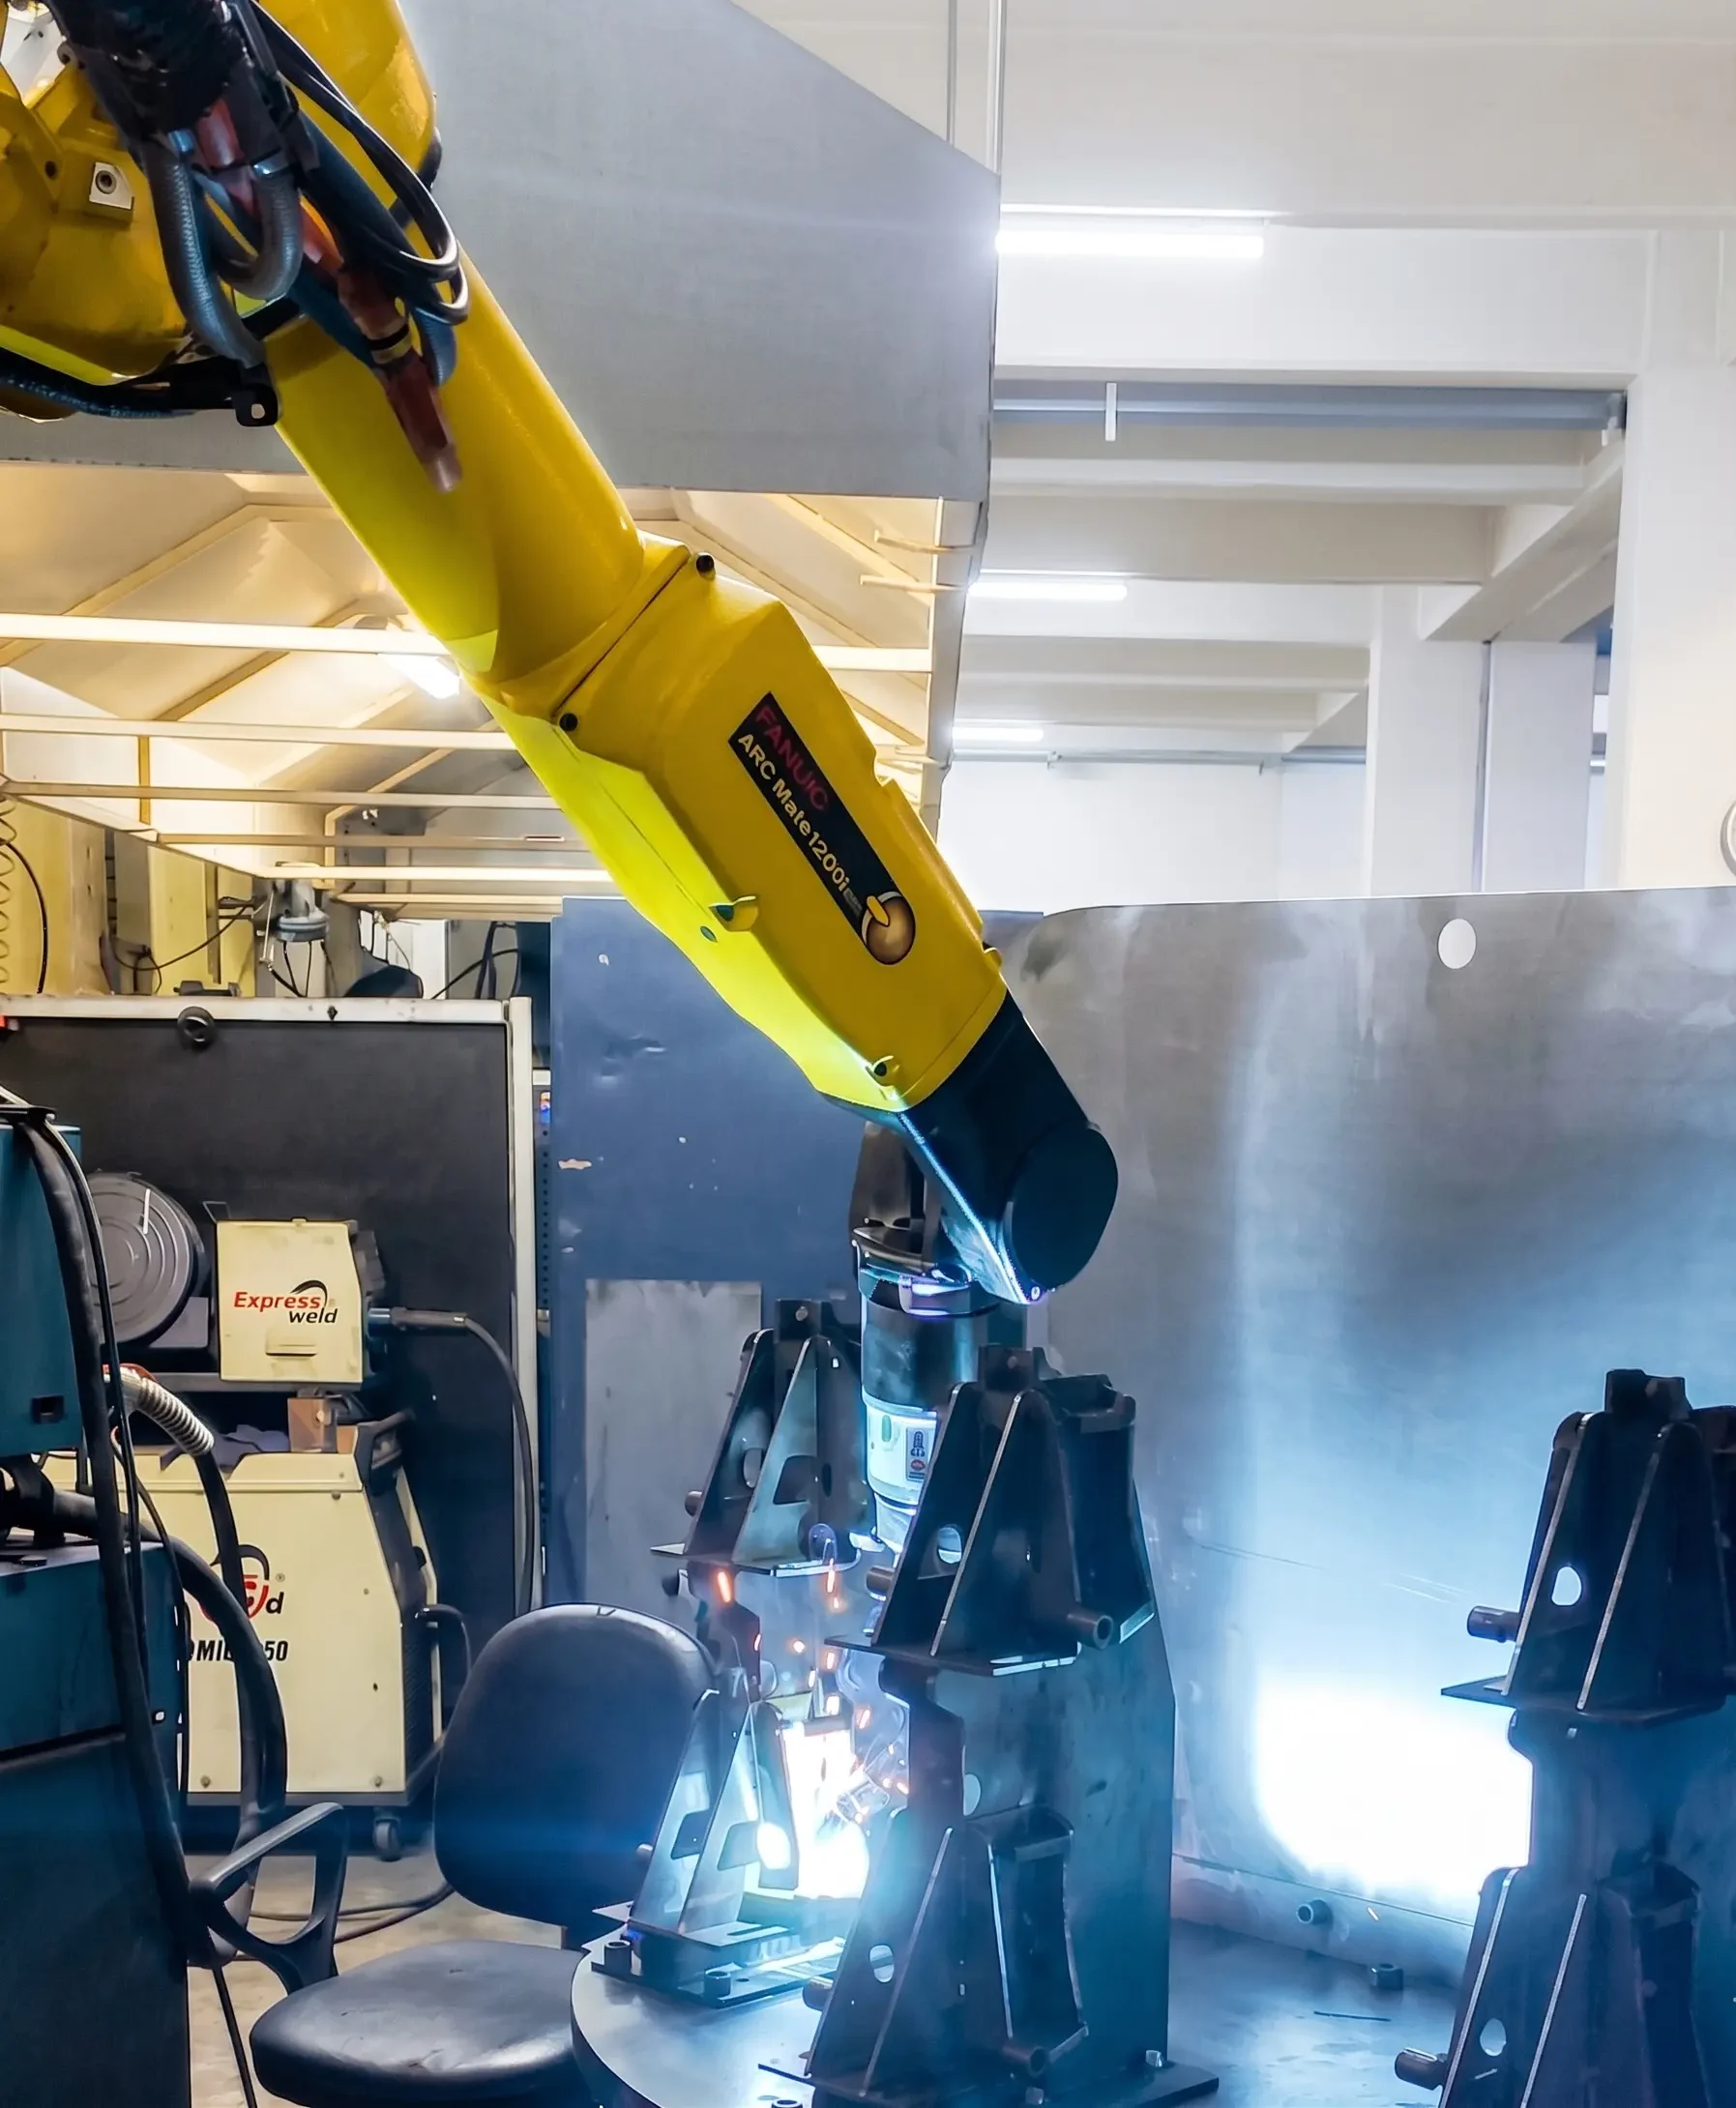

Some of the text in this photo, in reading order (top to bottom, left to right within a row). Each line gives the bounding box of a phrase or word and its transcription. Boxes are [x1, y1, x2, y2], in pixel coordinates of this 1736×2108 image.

[738, 734, 776, 780] ARC
[234, 1292, 321, 1312] Express
[289, 1307, 338, 1324] weld
[259, 1641, 288, 1661] 50
